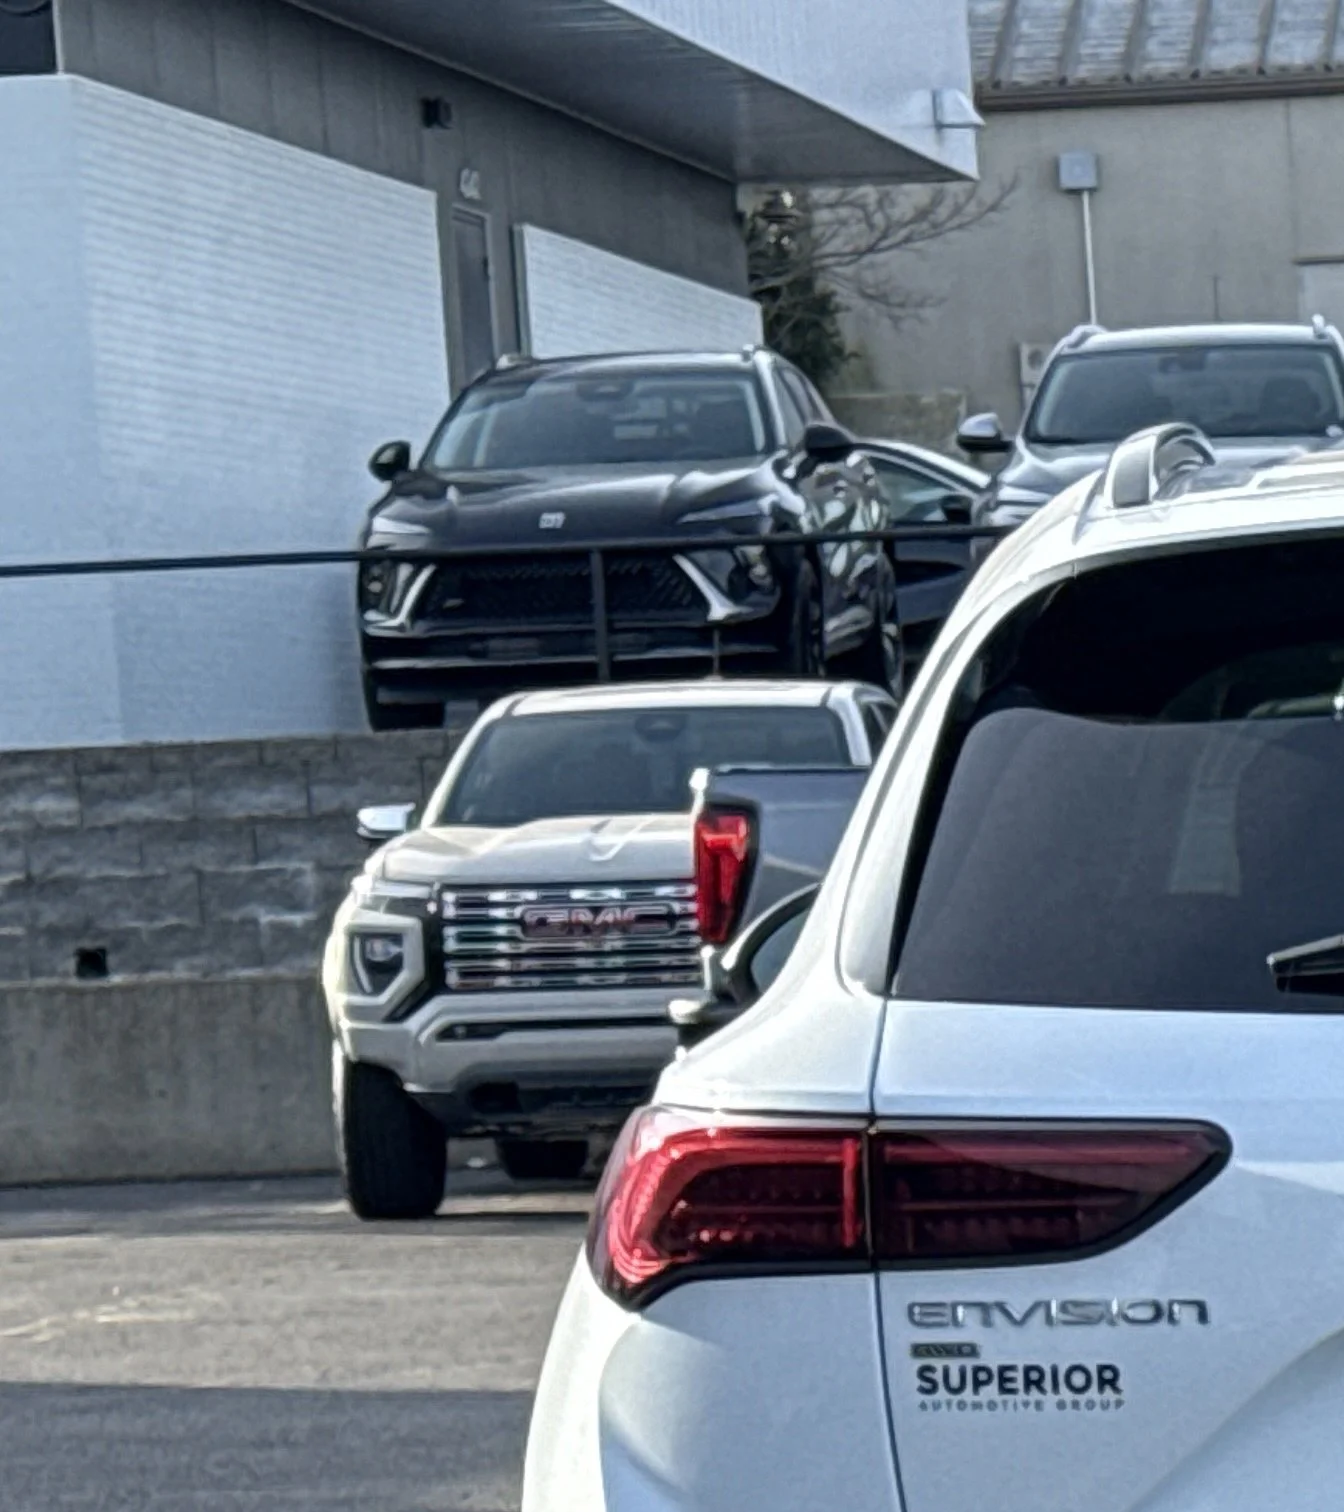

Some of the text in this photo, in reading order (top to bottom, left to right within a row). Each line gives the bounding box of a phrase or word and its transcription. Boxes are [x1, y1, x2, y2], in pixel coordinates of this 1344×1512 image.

[522, 906, 671, 937] GMC
[915, 1363, 1124, 1396] SUPERIOR
[917, 1398, 1125, 1412] AUTOMOTIVE GROUP
